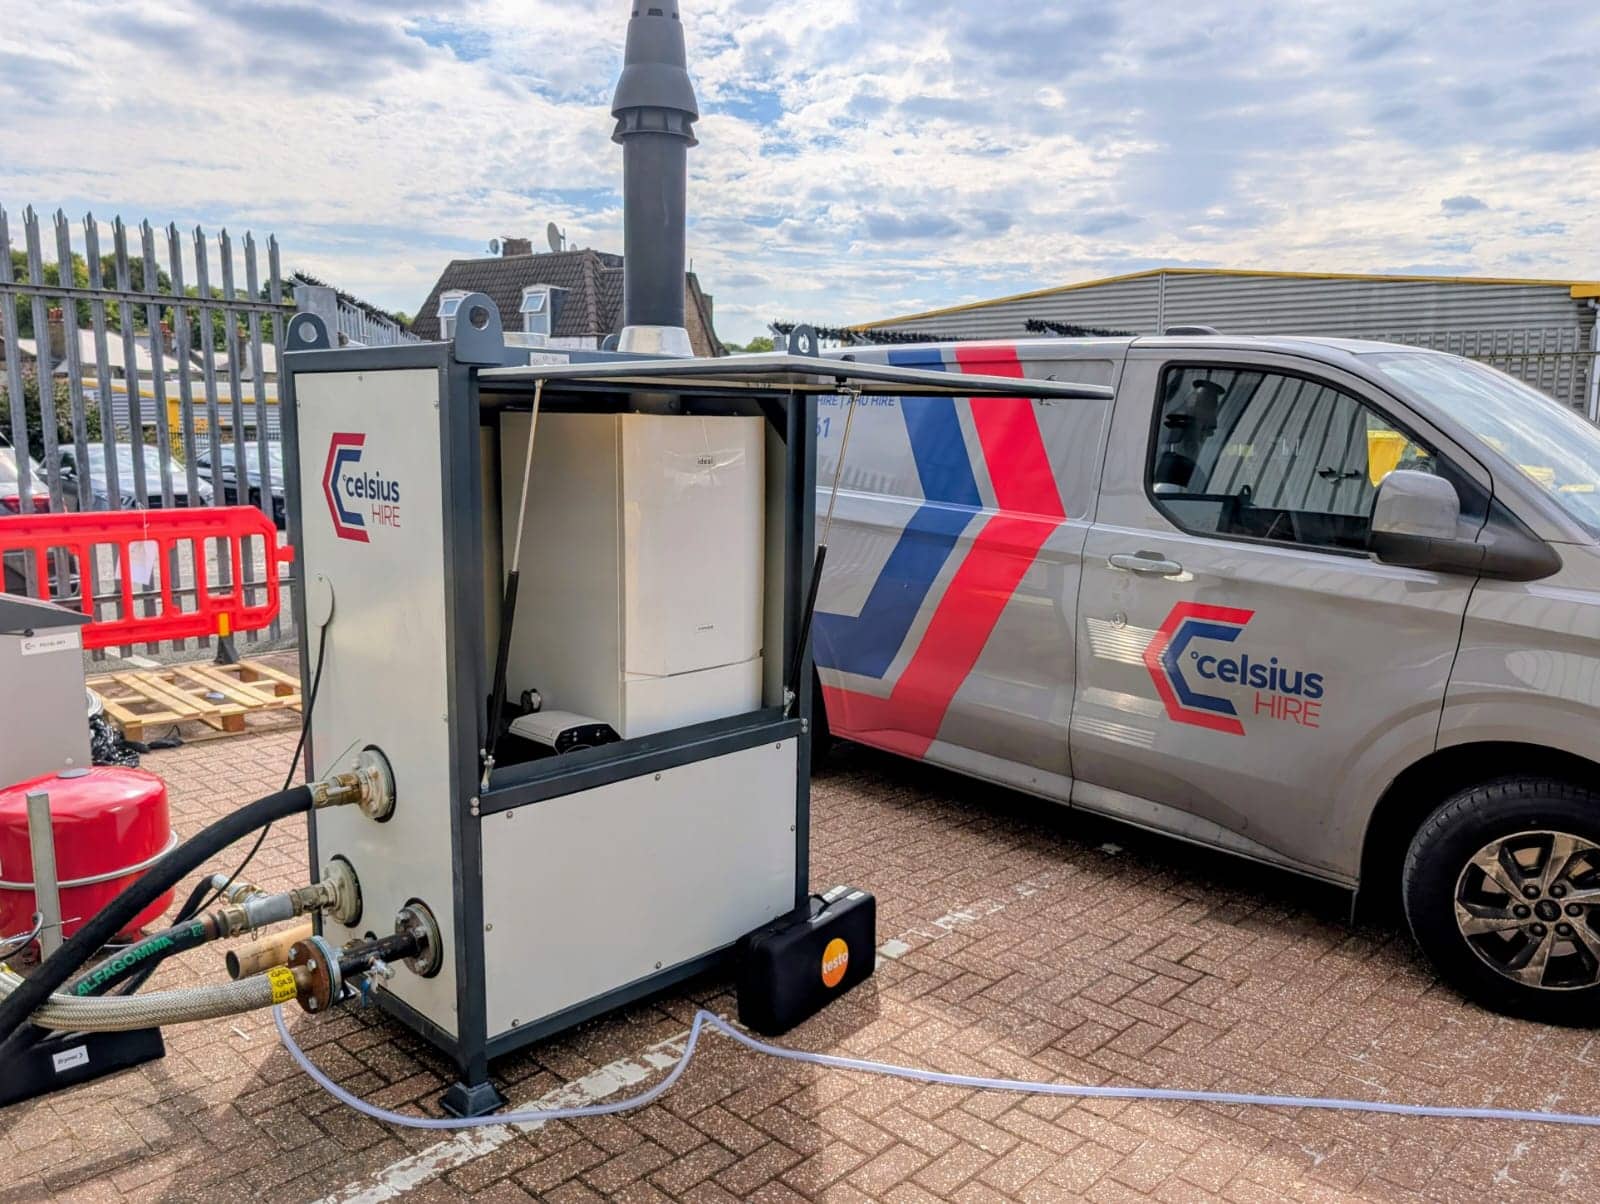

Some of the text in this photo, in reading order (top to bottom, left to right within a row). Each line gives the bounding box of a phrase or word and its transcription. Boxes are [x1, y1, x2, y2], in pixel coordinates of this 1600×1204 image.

[372, 504, 401, 528] HIRE
[1254, 690, 1323, 729] HIRE
[77, 935, 174, 996] ALFAGOMMA
[823, 952, 849, 975] testo
